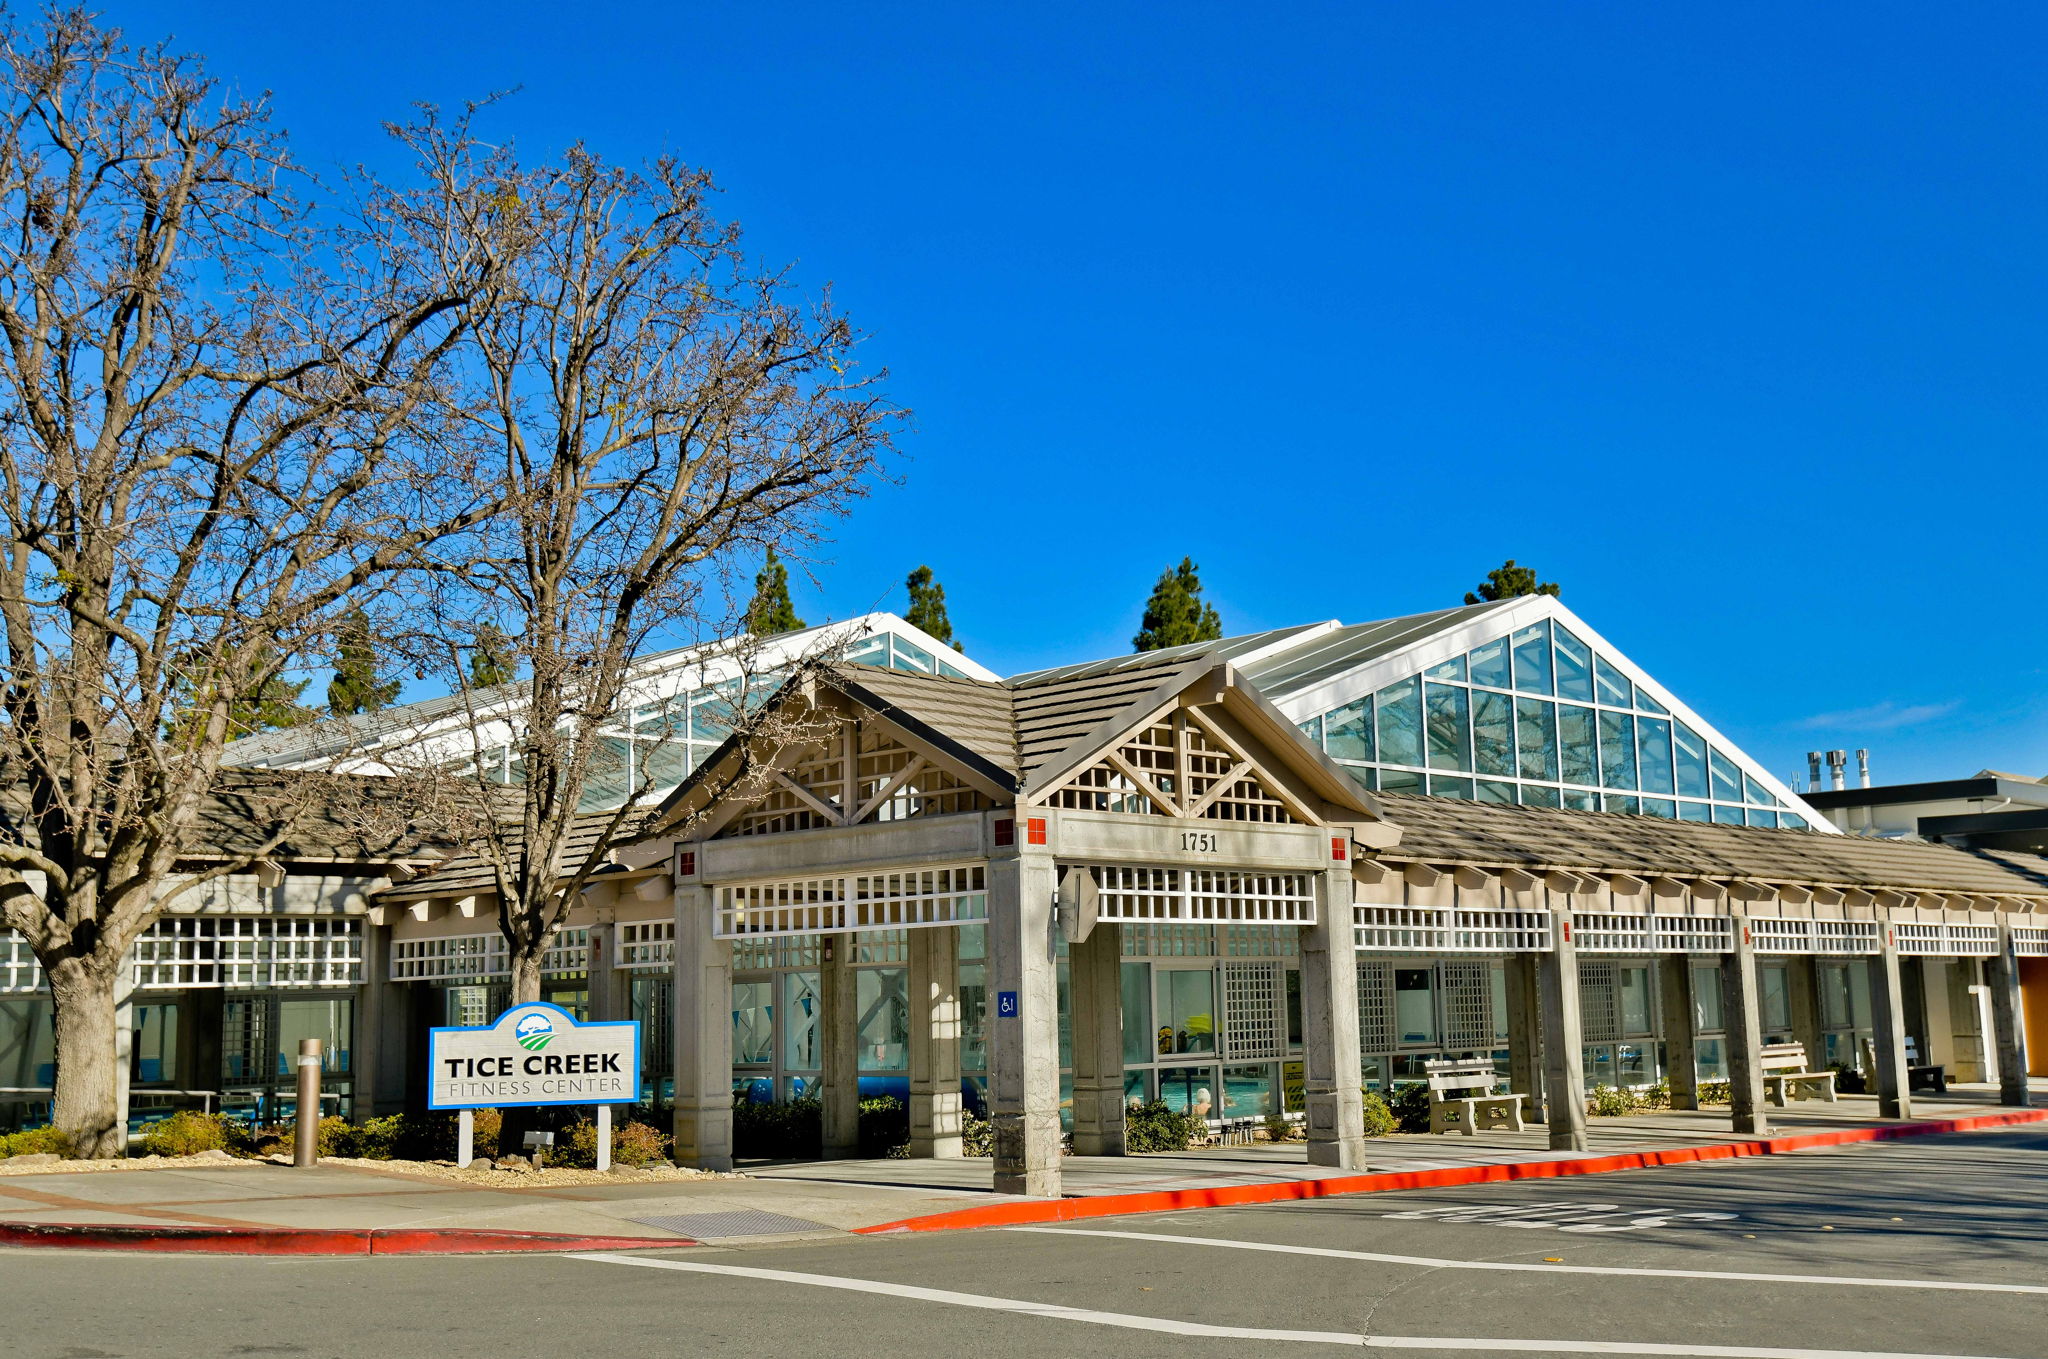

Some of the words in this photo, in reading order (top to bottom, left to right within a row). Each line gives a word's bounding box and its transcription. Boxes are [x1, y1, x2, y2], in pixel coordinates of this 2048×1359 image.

[1181, 833, 1217, 852] 1751
[445, 1057, 513, 1078] TICE
[523, 1053, 621, 1075] CREEK
[450, 1081, 530, 1097] FITNESS
[542, 1078, 622, 1094] CENTER
